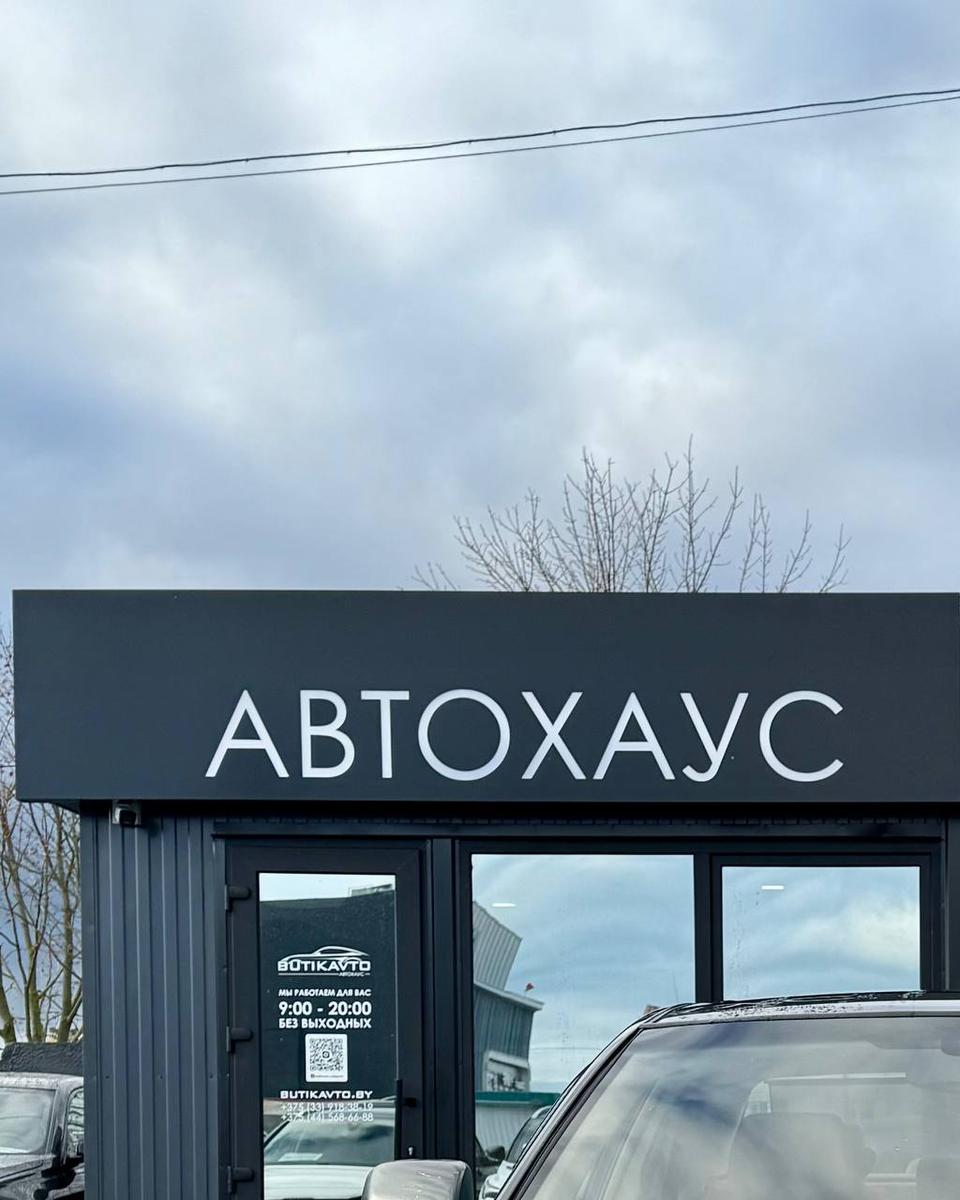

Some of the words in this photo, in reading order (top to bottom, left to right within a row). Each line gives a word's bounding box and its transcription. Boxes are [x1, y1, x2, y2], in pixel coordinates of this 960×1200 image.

[205, 688, 844, 783] АВТОХАУС
[277, 960, 371, 972] BUTIKAVTO
[278, 989, 293, 997] МЫ
[294, 989, 336, 997] РАБОТАЕМ
[336, 989, 353, 997] ДЛЯ
[354, 989, 372, 997] ВАС
[278, 1001, 313, 1015] 9:00
[328, 1001, 372, 1015] 20:00
[278, 1018, 299, 1029] БЕЗ
[301, 1018, 372, 1030] ВЫХОДНЫХ
[280, 1090, 374, 1099] BUTIKAVTO.BY
[280, 1102, 304, 1112] +375
[306, 1102, 325, 1113] (33)
[280, 1112, 304, 1122] +375
[327, 1112, 374, 1122] 568-66-88
